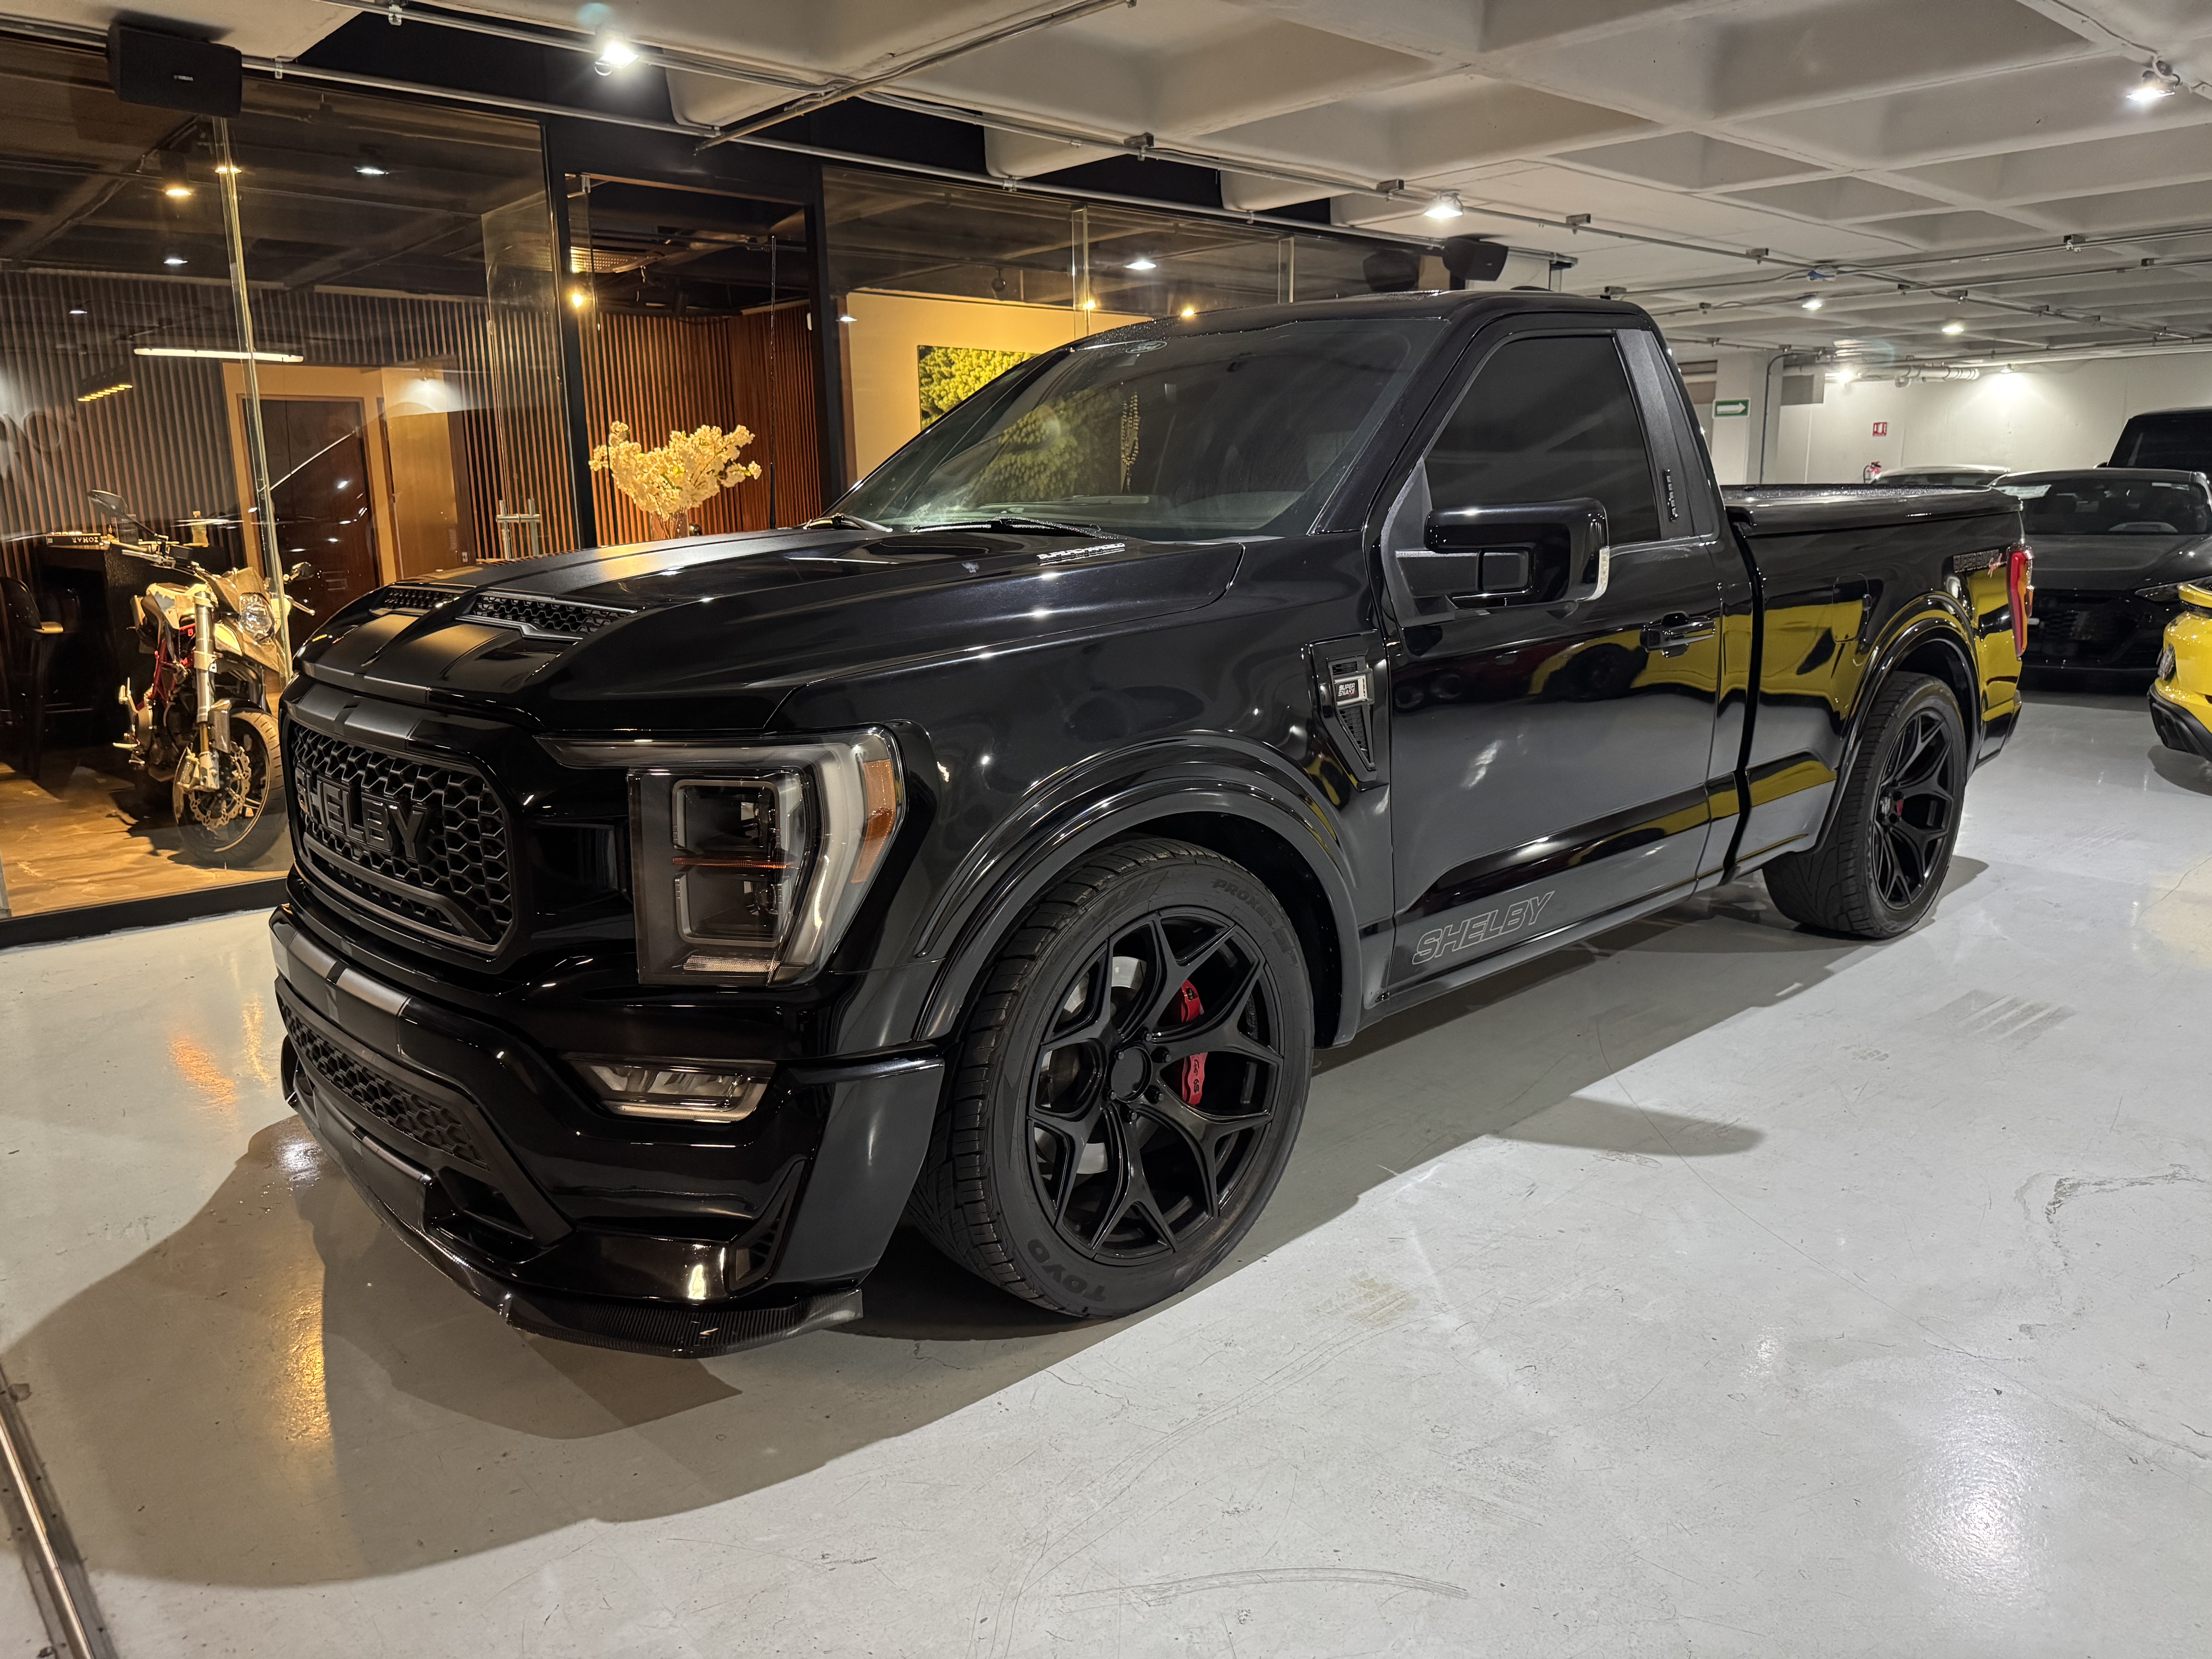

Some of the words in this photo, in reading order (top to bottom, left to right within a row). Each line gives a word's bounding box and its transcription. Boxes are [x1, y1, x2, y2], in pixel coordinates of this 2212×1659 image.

[1338, 689, 1355, 697] SNAKE
[295, 763, 427, 862] SHELBY
[1212, 879, 1276, 926] PROXES
[1412, 891, 1555, 965] SHELBY
[1027, 1239, 1106, 1302] TOYO
